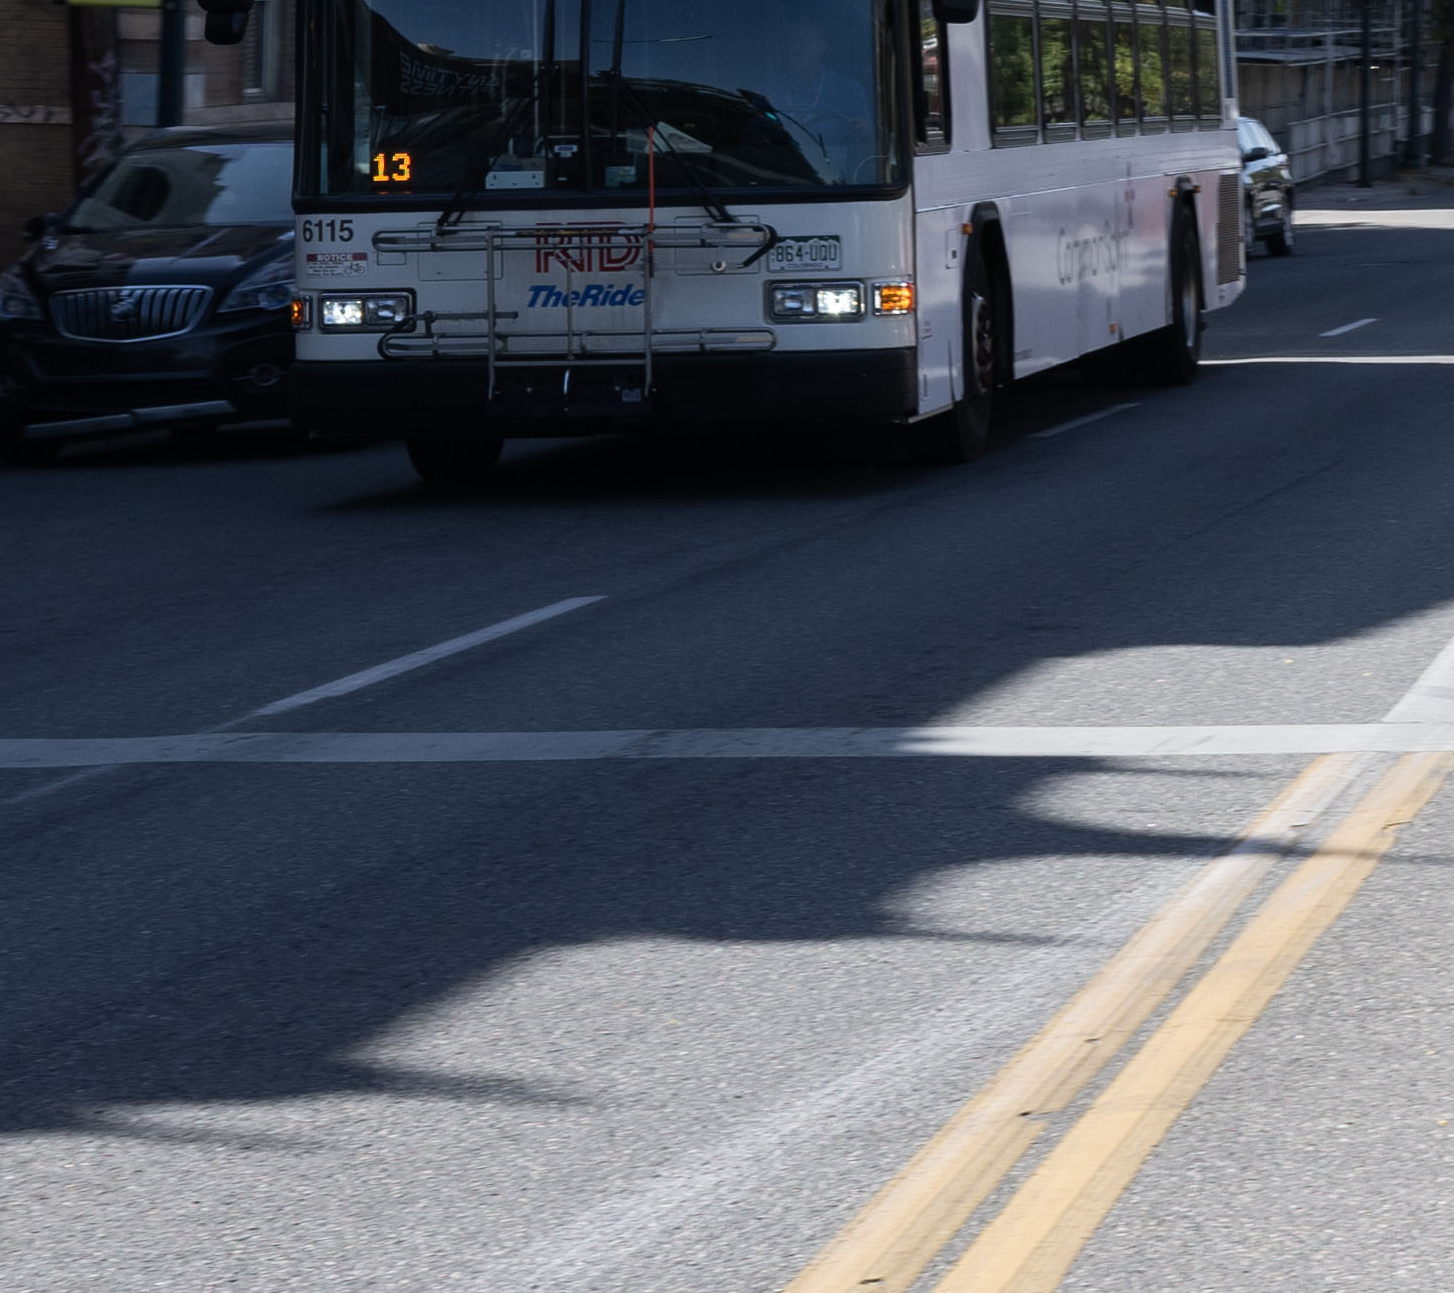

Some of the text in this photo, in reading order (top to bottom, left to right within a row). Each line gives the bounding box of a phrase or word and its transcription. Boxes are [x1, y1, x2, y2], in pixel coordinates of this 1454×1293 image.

[372, 152, 413, 182] 13
[302, 219, 354, 243] 6115
[316, 253, 354, 262] NOTICE
[535, 221, 642, 273] RTD
[527, 283, 645, 308] TheRide
